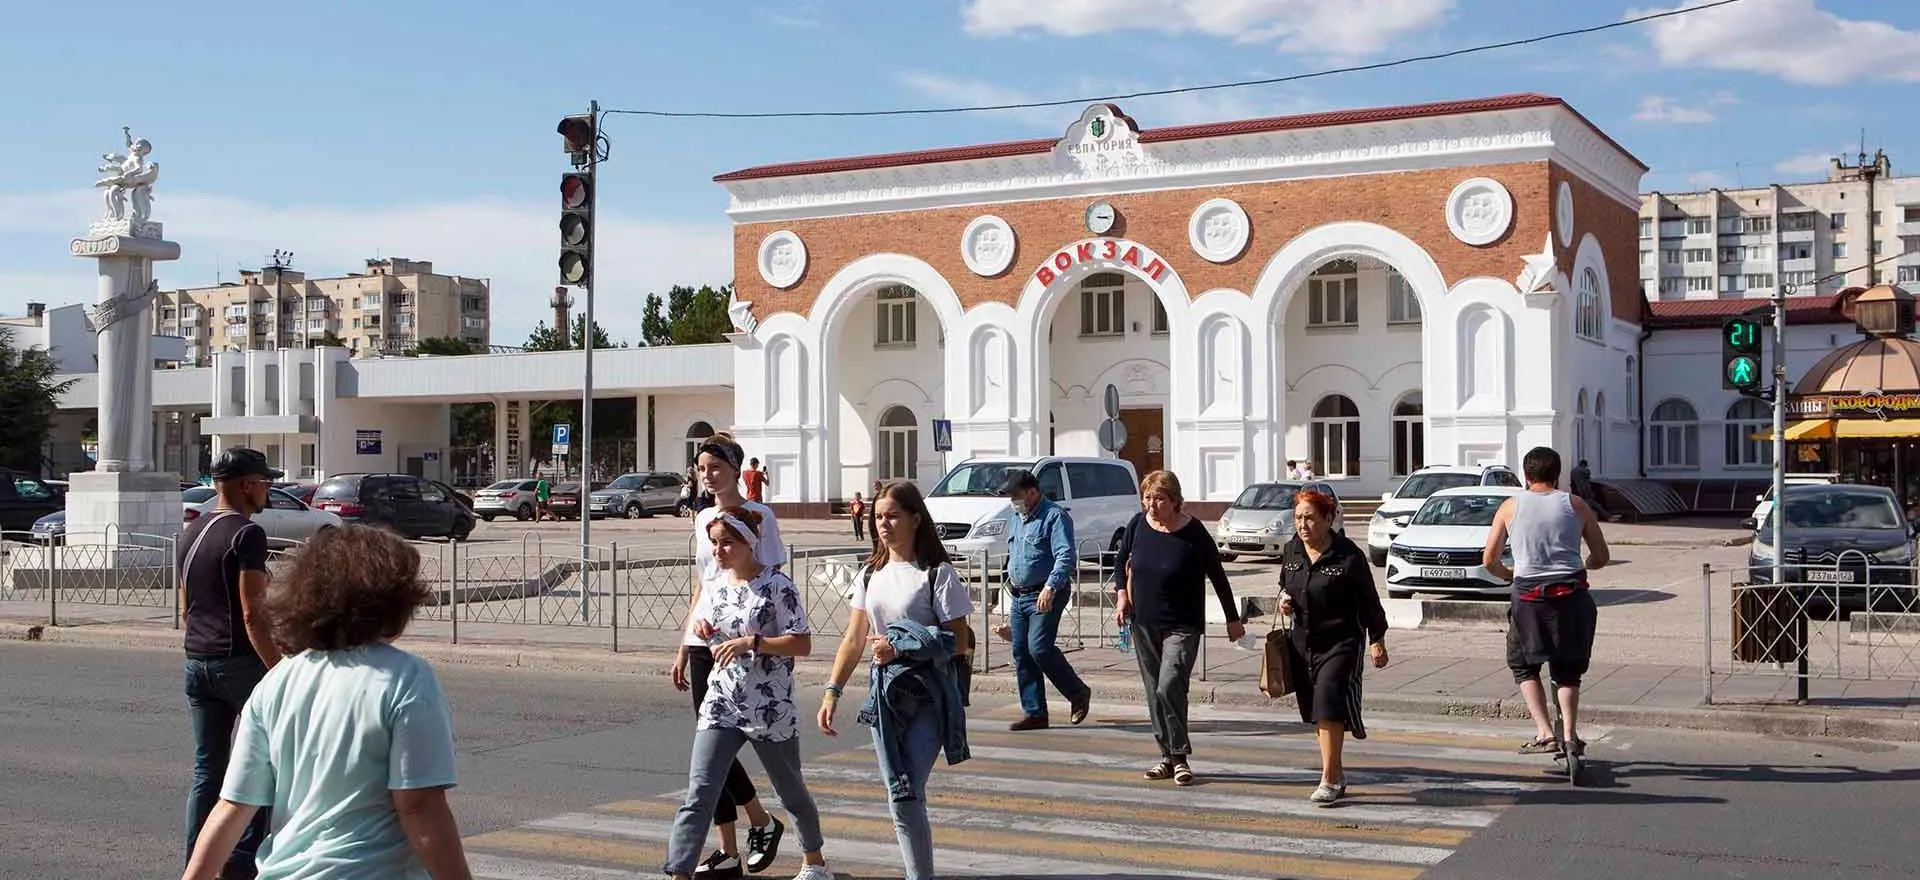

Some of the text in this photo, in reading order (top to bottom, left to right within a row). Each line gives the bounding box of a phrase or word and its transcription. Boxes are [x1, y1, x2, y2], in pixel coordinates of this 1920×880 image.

[1068, 139, 1132, 154] ЕВПАТОРИЯ
[1036, 240, 1166, 288] ВОКЗАЛ
[1730, 323, 1753, 345] 21
[557, 427, 567, 441] P
